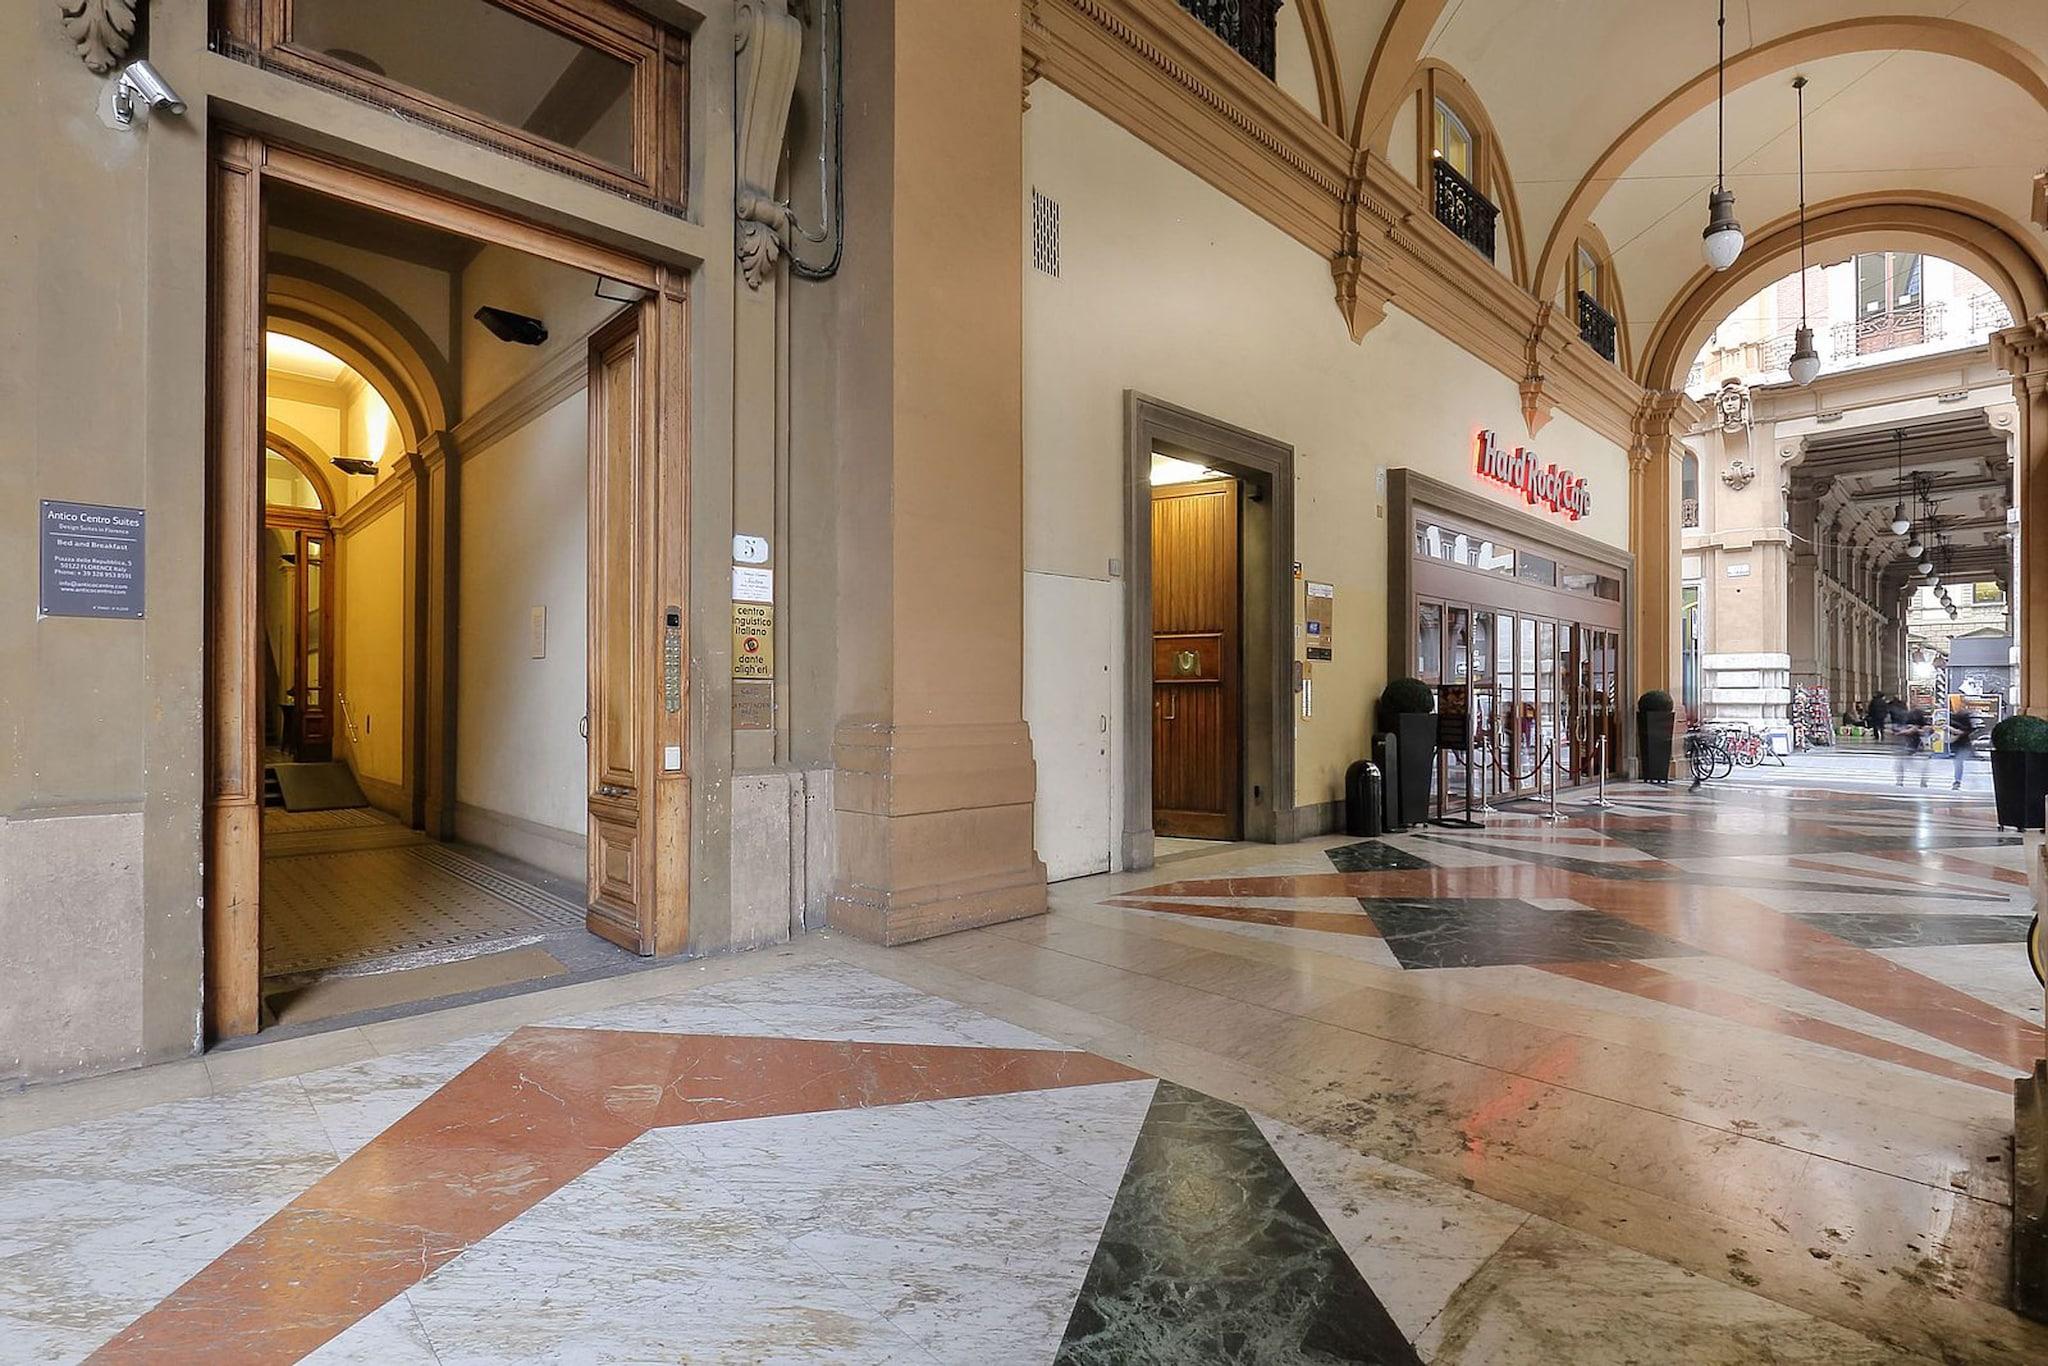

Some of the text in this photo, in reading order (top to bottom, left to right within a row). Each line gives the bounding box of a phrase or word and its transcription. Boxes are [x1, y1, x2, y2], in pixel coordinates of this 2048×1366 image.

[1476, 429, 1525, 489] Hard
[1521, 451, 1561, 513] Rock
[47, 510, 140, 528] Antico Centro Suites
[59, 523, 79, 531] Design
[104, 527, 129, 535] Florence
[57, 539, 73, 547] Bed
[91, 542, 128, 551] Breakfast
[54, 555, 75, 563] Piazza
[80, 564, 113, 572] FLORENCE
[737, 607, 765, 616] centro
[731, 615, 772, 627] inguistico
[735, 626, 767, 636] italiano
[738, 654, 764, 664] dante
[734, 664, 768, 676] alighieri
